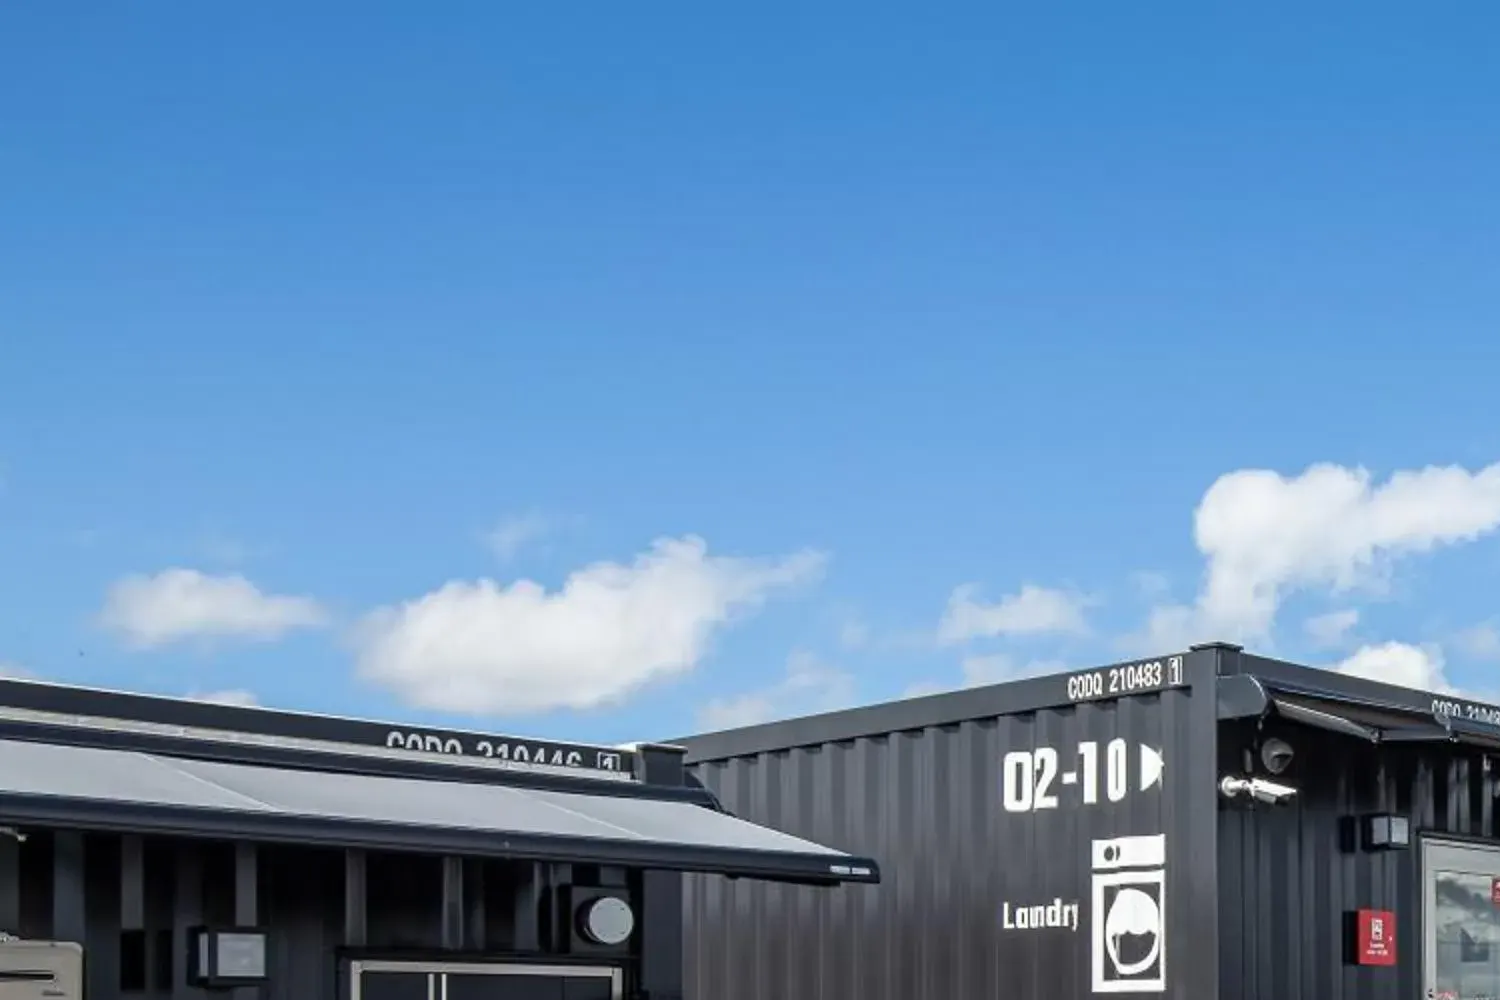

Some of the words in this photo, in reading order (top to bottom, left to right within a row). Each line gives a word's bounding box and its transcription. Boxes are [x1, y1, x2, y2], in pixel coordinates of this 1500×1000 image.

[1068, 672, 1103, 699] CODQ
[1109, 662, 1161, 692] 210483
[1003, 738, 1127, 812] 02-10
